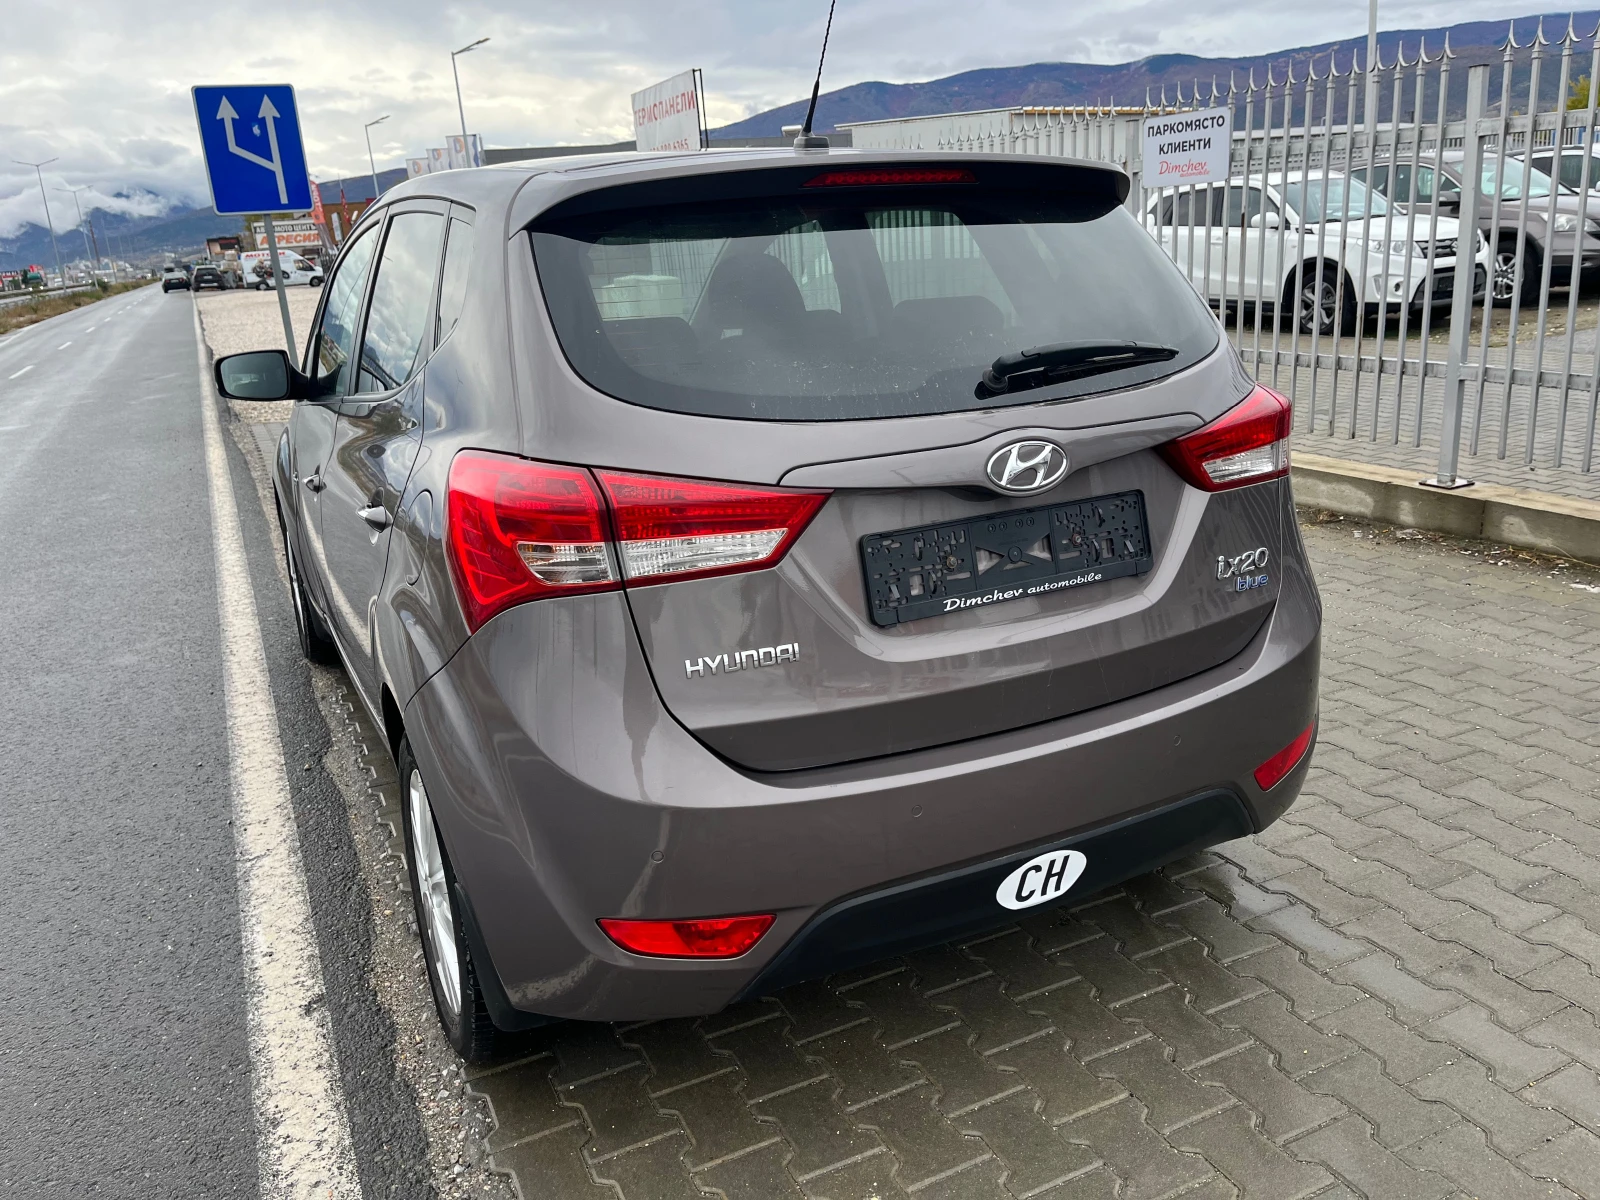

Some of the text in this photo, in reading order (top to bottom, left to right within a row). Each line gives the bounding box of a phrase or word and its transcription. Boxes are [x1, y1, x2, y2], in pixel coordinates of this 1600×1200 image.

[1147, 115, 1225, 137] ПАРКОМЯСТО
[1158, 137, 1211, 155] КЛИЕНТИ
[1158, 158, 1208, 175] Dimchev
[260, 233, 320, 245] АРЕСИЯ
[1217, 547, 1269, 580] ix20
[943, 572, 1103, 612] Dimchev automobile
[1235, 574, 1269, 592] blue
[684, 642, 800, 679] HYUNDAI
[1015, 854, 1070, 903] CH
